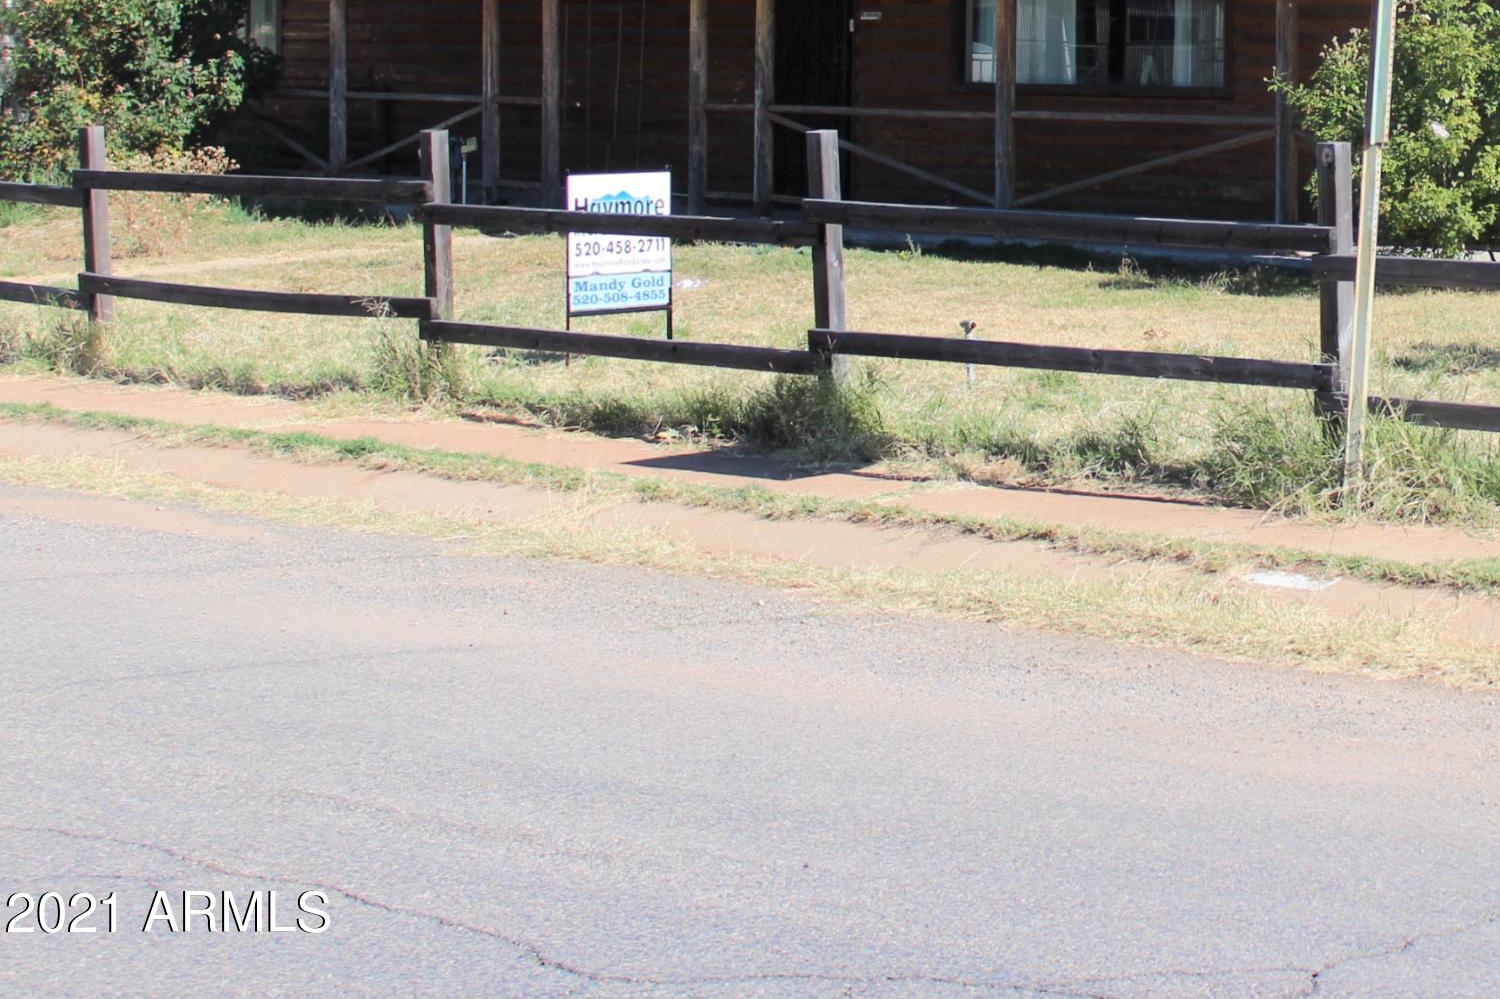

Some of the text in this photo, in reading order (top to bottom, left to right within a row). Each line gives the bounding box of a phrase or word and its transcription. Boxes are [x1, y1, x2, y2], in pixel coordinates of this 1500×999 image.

[575, 238, 666, 257] 520-458-2711
[574, 276, 665, 292] Mandy Gold
[573, 290, 666, 306] 520-508-4855
